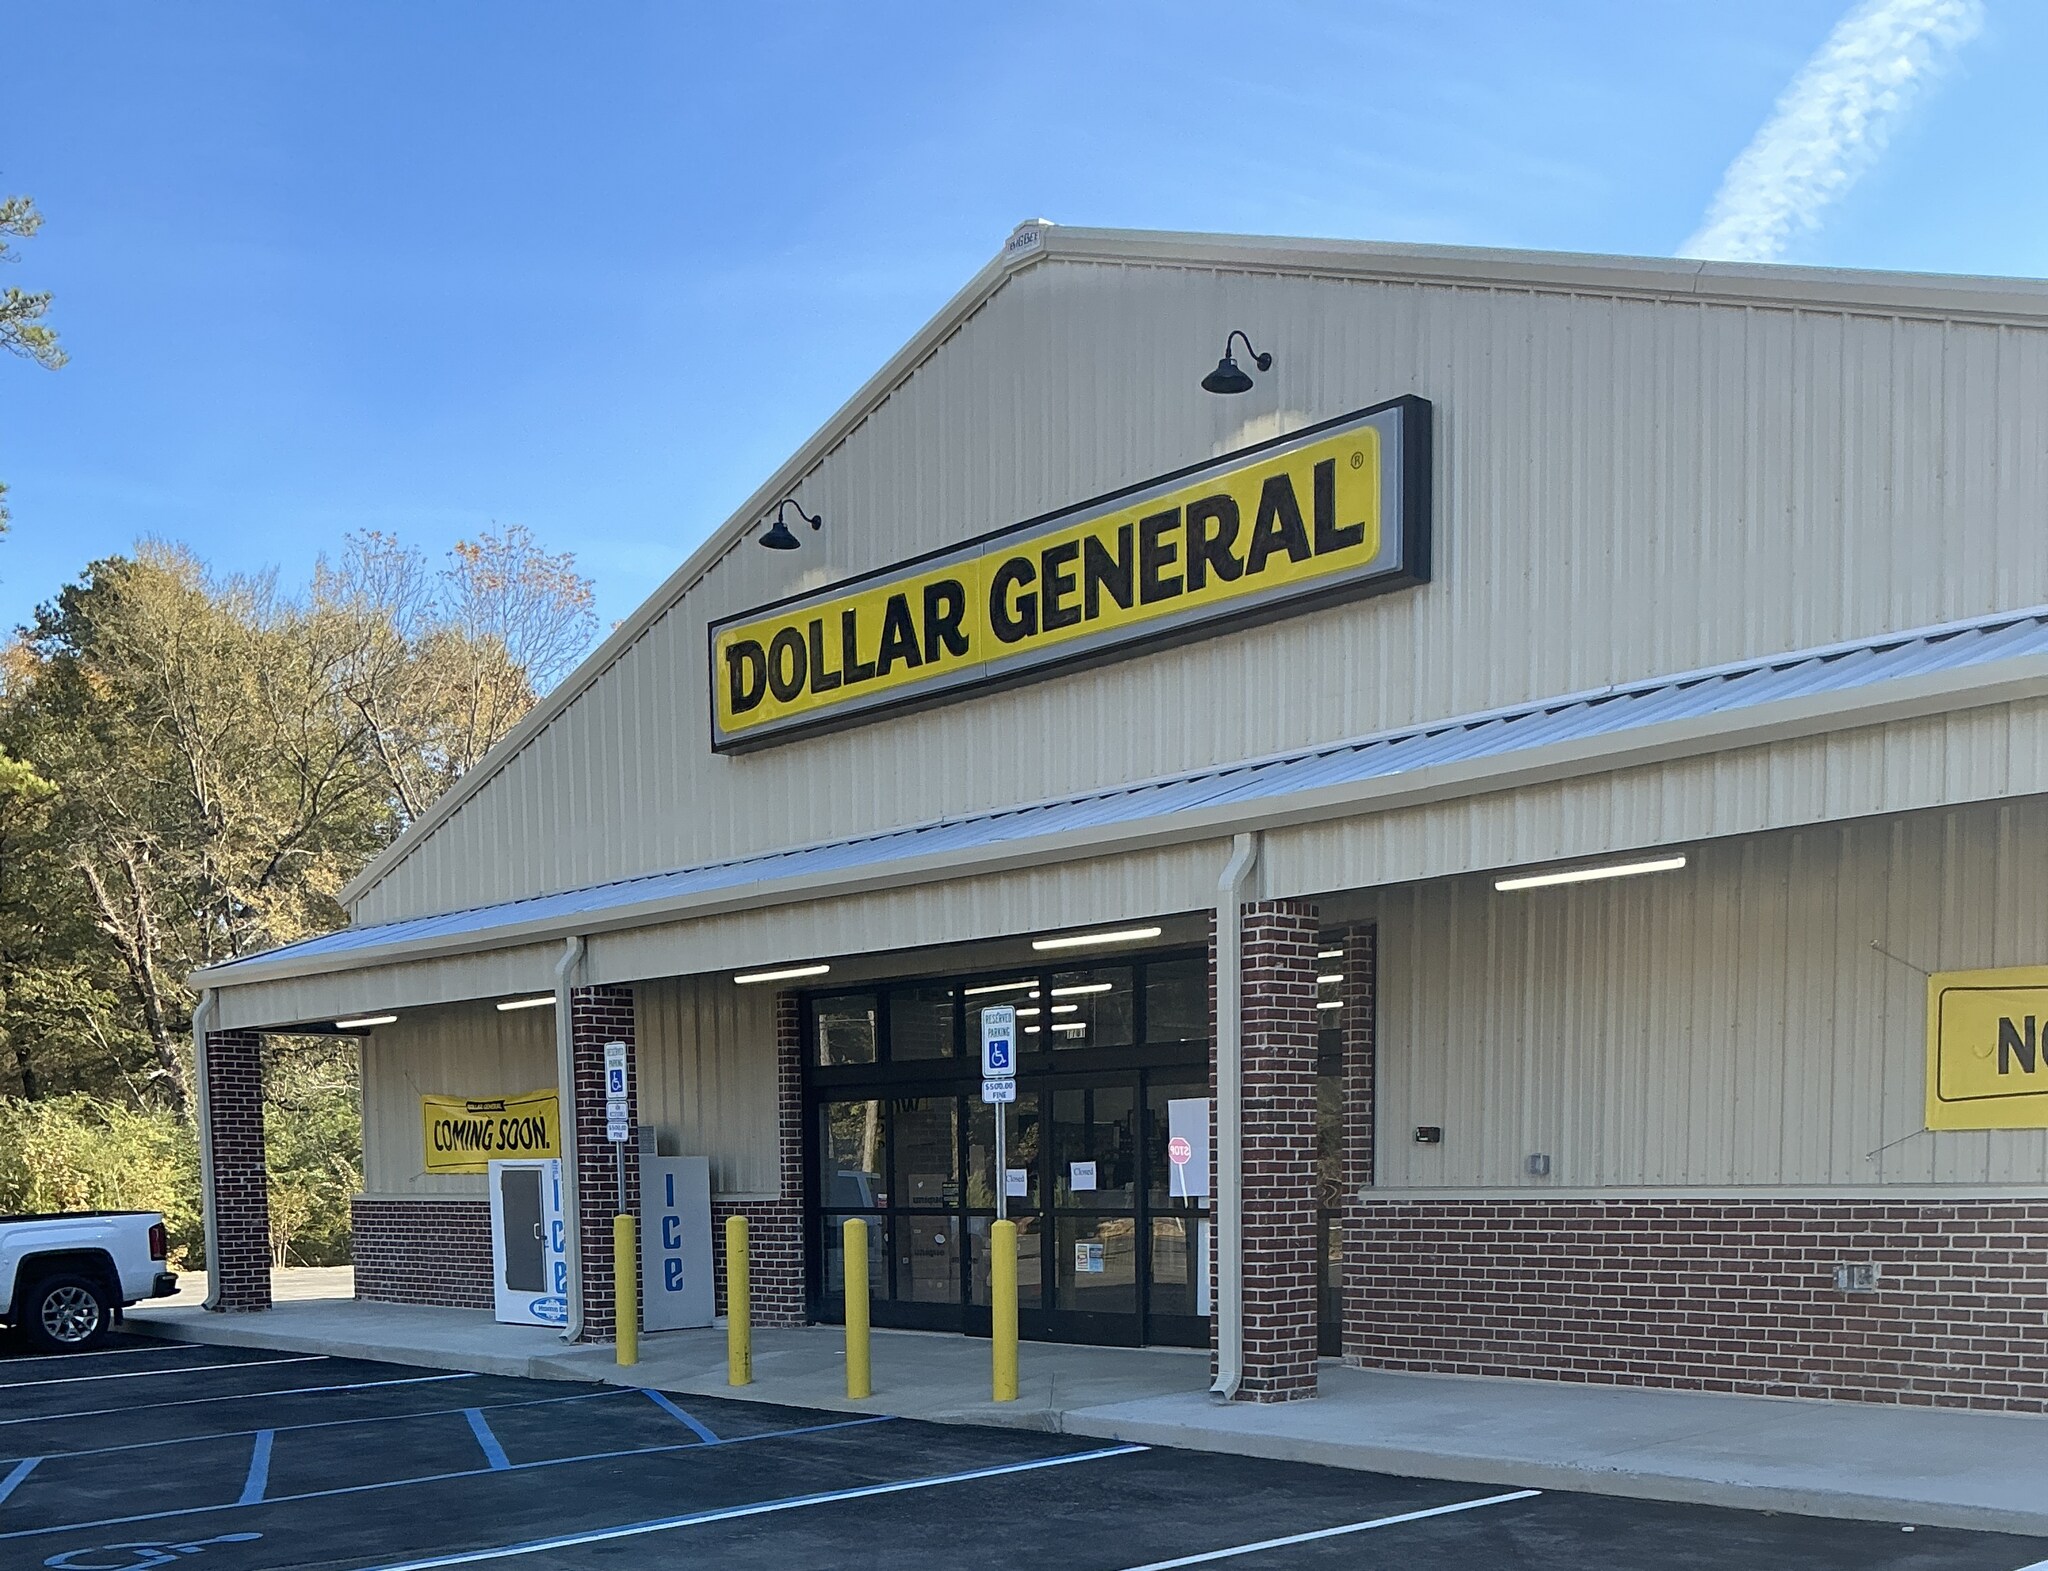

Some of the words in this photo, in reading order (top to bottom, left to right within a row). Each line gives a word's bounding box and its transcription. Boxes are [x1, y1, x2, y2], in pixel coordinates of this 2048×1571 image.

[725, 578, 970, 715] DOLLAR
[988, 458, 1365, 643] GENERAL
[985, 1012, 1012, 1025] RESERVED
[987, 1027, 1010, 1038] PARKING
[1997, 1015, 2048, 1075] N
[992, 1091, 1007, 1099] FINE
[434, 1119, 494, 1151] COMING
[496, 1115, 550, 1150] SOON.
[1073, 1167, 1094, 1176] Closed
[1006, 1174, 1025, 1183] Closed
